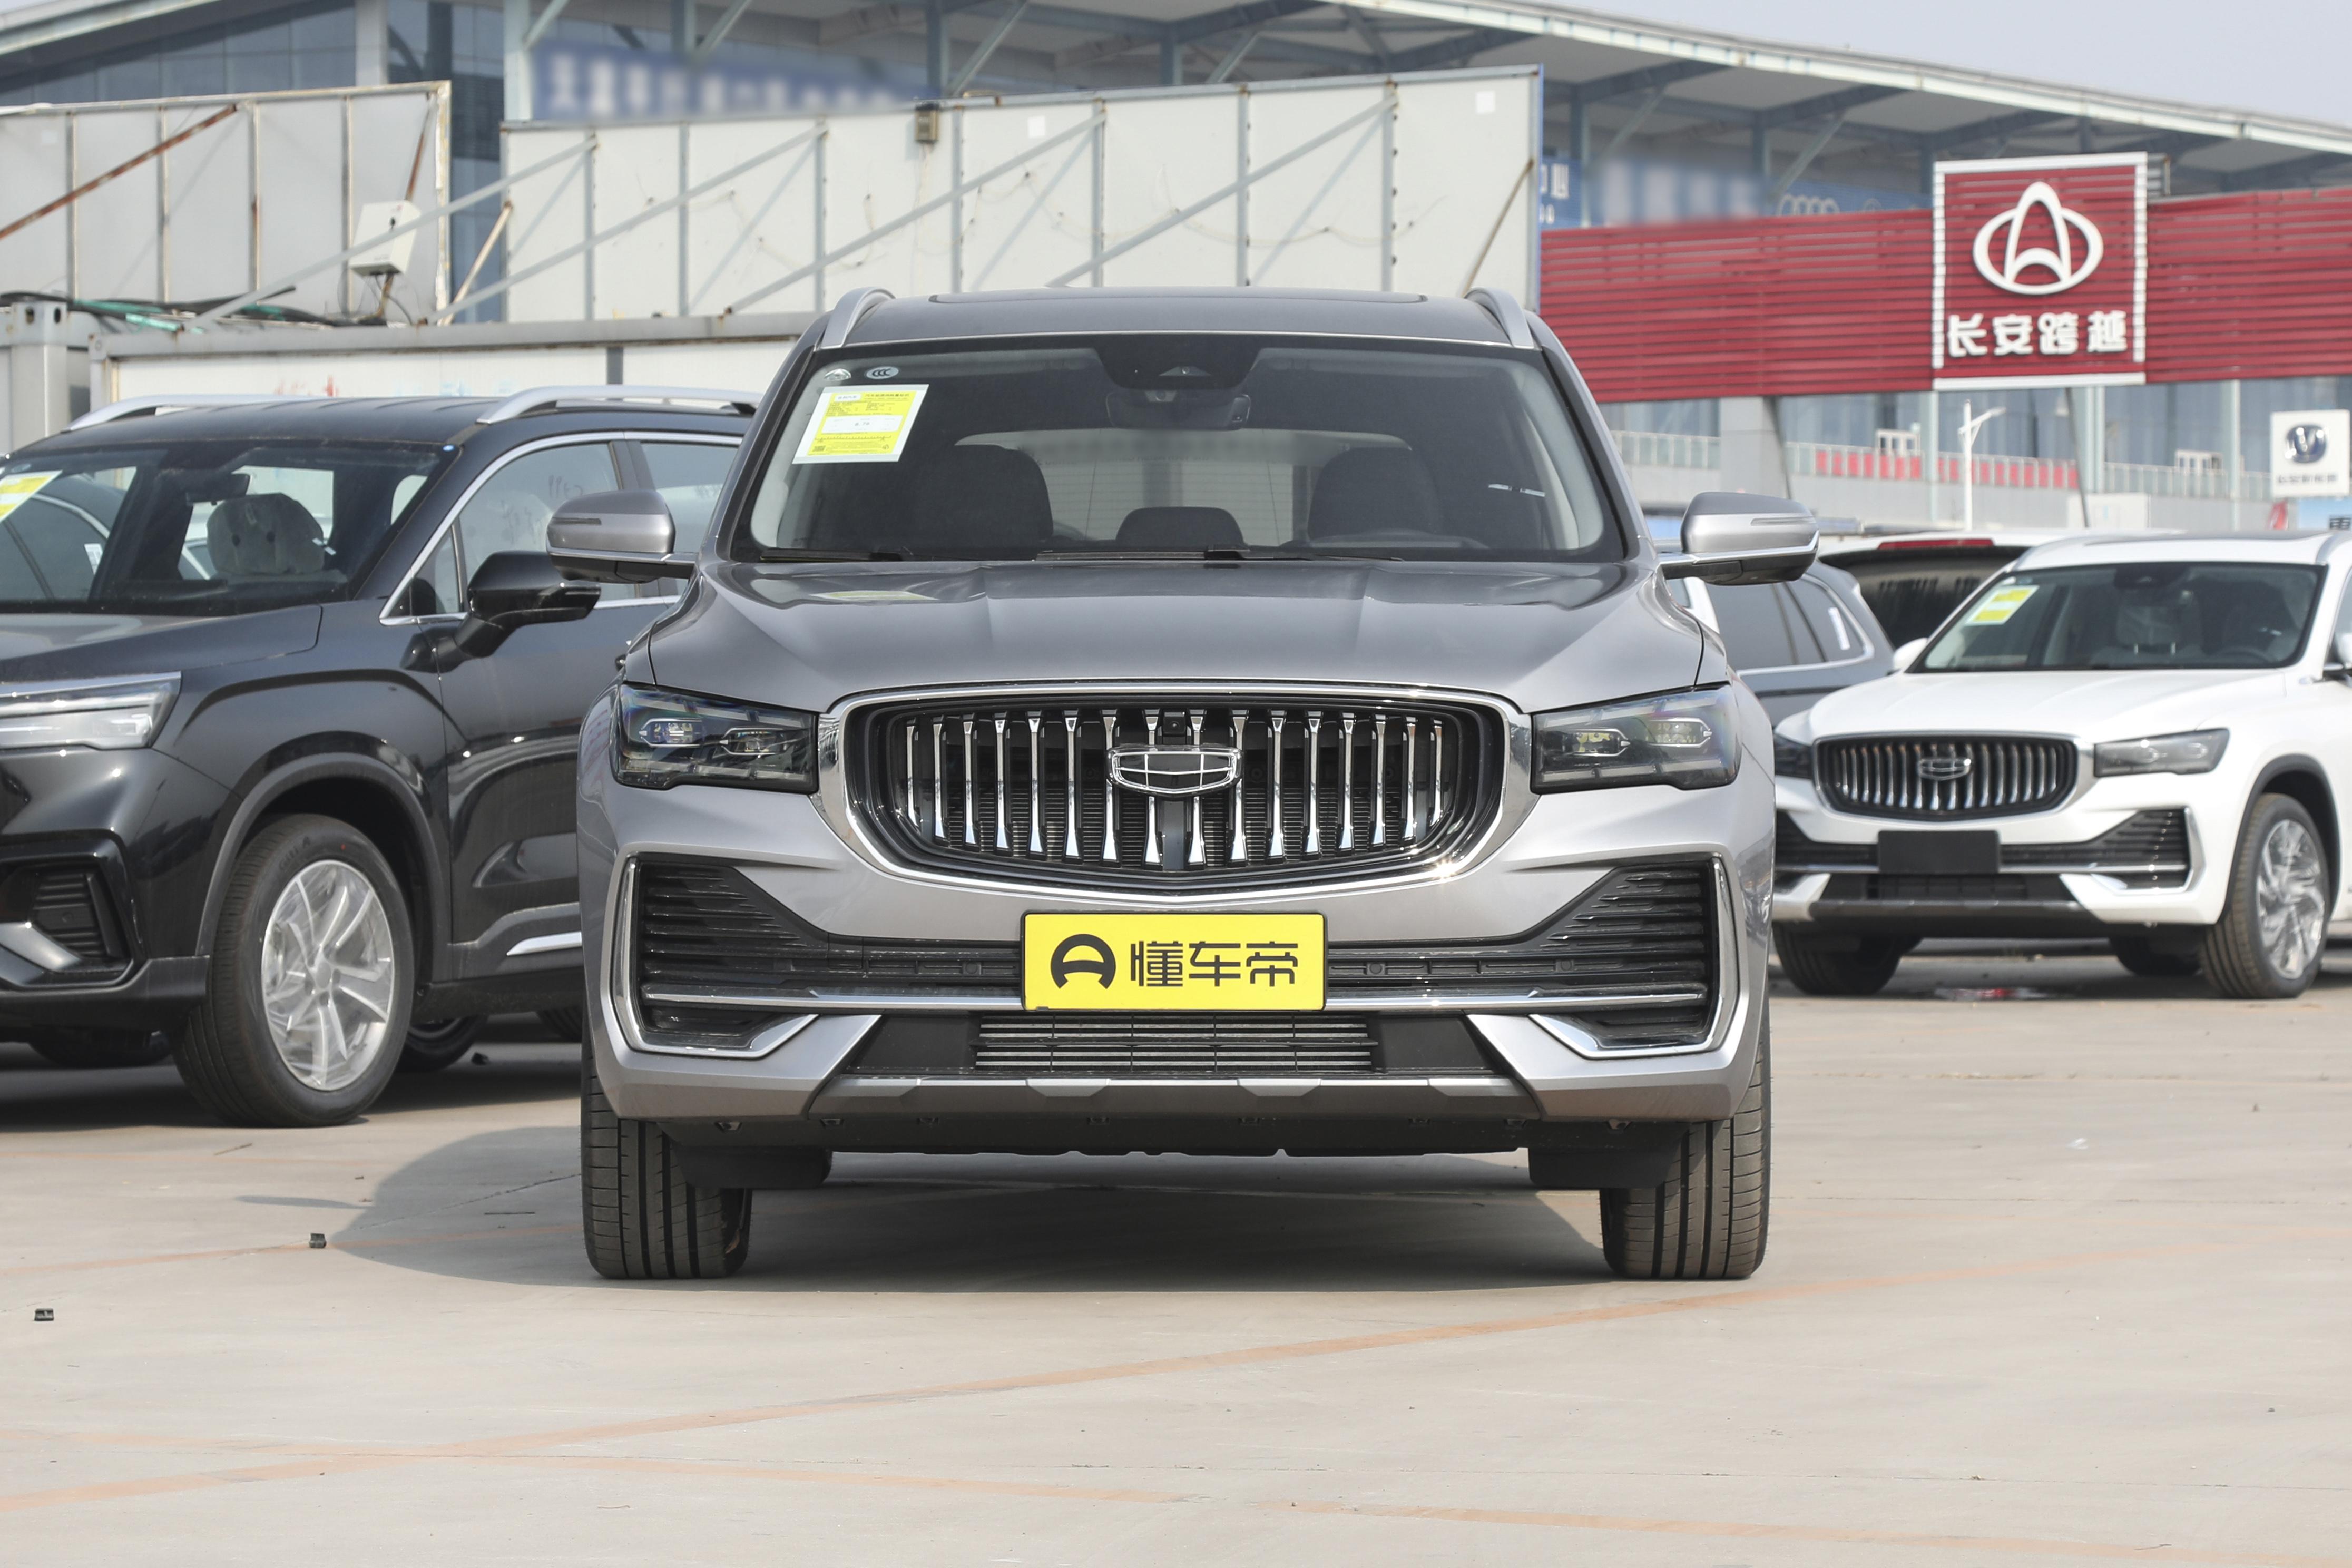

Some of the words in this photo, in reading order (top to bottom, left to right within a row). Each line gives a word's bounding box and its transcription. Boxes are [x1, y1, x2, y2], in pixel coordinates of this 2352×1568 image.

[1947, 310, 2128, 357] 长安跨越
[1130, 940, 1299, 987] 懂车帝
